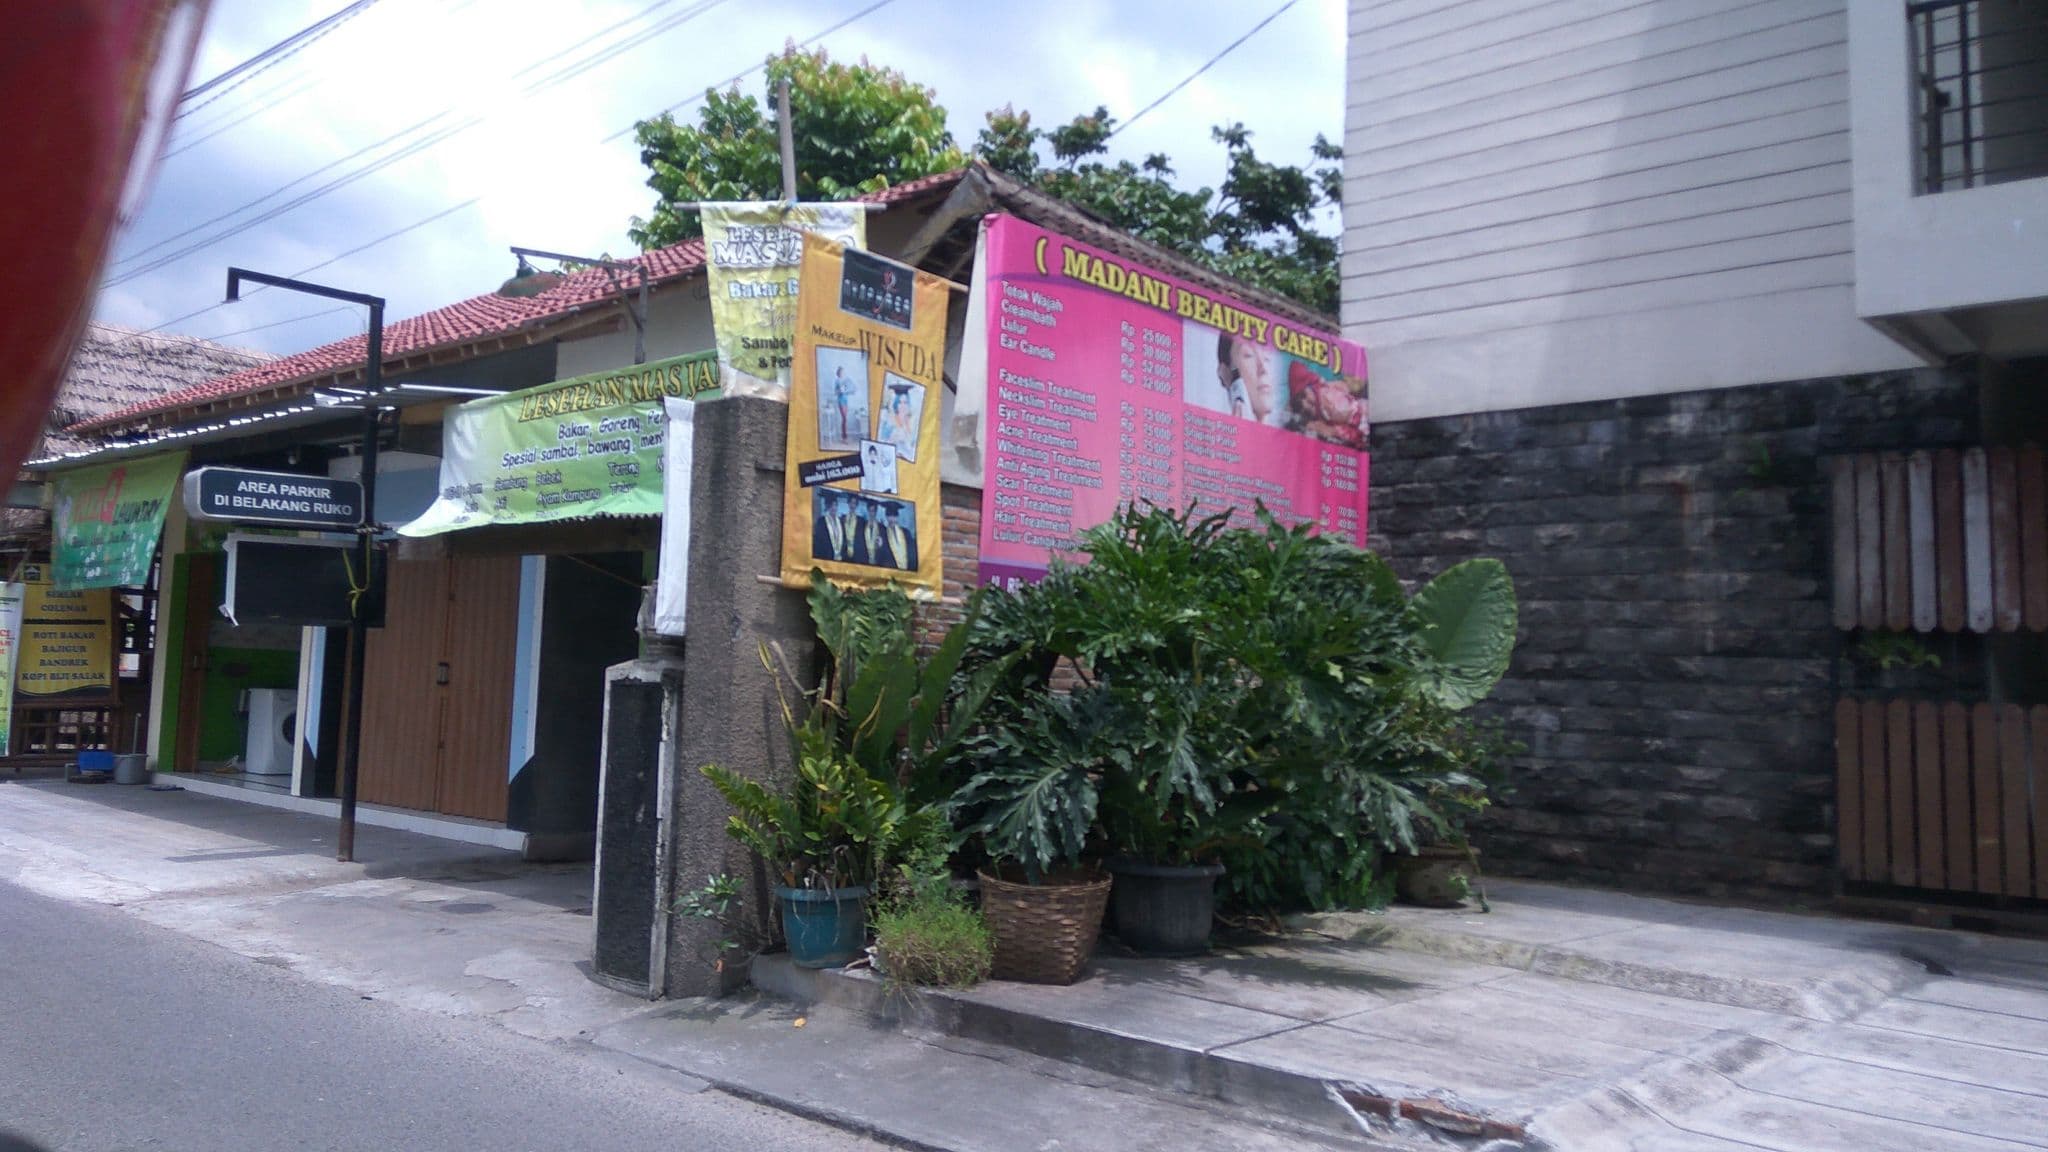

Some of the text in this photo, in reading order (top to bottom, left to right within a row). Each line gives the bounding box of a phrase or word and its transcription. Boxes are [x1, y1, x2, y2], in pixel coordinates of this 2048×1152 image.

[1061, 246, 1172, 313] MADANI
[1176, 287, 1270, 344] BEAUTY
[1273, 324, 1329, 366] CARE
[858, 328, 937, 381] WISUDA
[1000, 333, 1056, 361] Ear Candle
[518, 378, 625, 422] LESEHAN
[629, 365, 682, 402] MAS
[1047, 381, 1097, 405] Treatment
[998, 403, 1072, 433] Eye Treatment
[1048, 399, 1097, 423] Treatment
[997, 421, 1079, 450] Acne Treatment
[502, 452, 536, 469] Spesial
[996, 438, 1102, 473] Whitening Treatment
[237, 480, 331, 500] AREA PARKIR
[1023, 479, 1074, 501] Treatment
[1053, 467, 1104, 490] Treatment
[215, 494, 352, 516] DI BELAKANG RUKO
[536, 491, 560, 506] Ayam
[1023, 496, 1074, 518] Treatment
[1018, 512, 1072, 534] Treatment
[60, 632, 96, 640] BAKAR
[71, 672, 105, 681] SALAK
